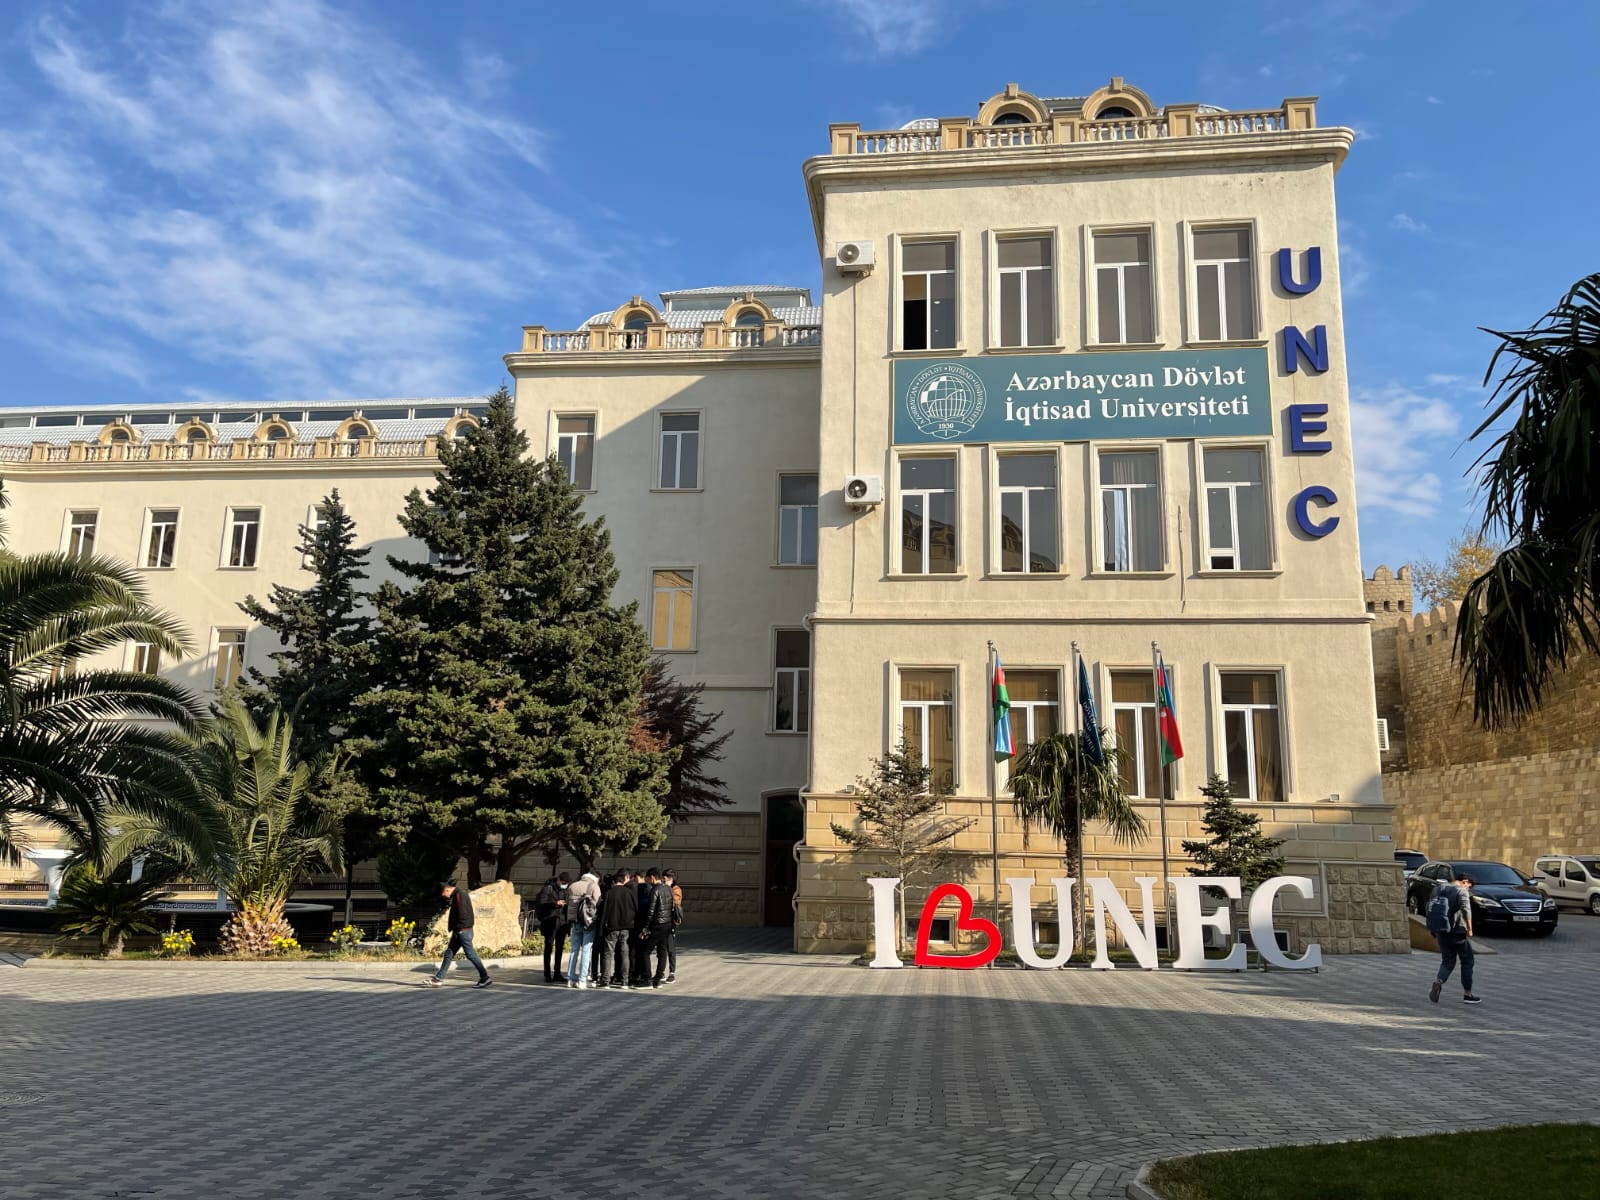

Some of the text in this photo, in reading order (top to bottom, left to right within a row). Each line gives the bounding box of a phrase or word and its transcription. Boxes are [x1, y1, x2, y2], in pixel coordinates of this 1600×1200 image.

[1004, 394, 1250, 426] İqtisad Universiteti
[1005, 365, 1247, 394] Azərbaycan Dövlət
[1278, 246, 1340, 538] UNEC
[1005, 875, 1323, 970] UNEC
